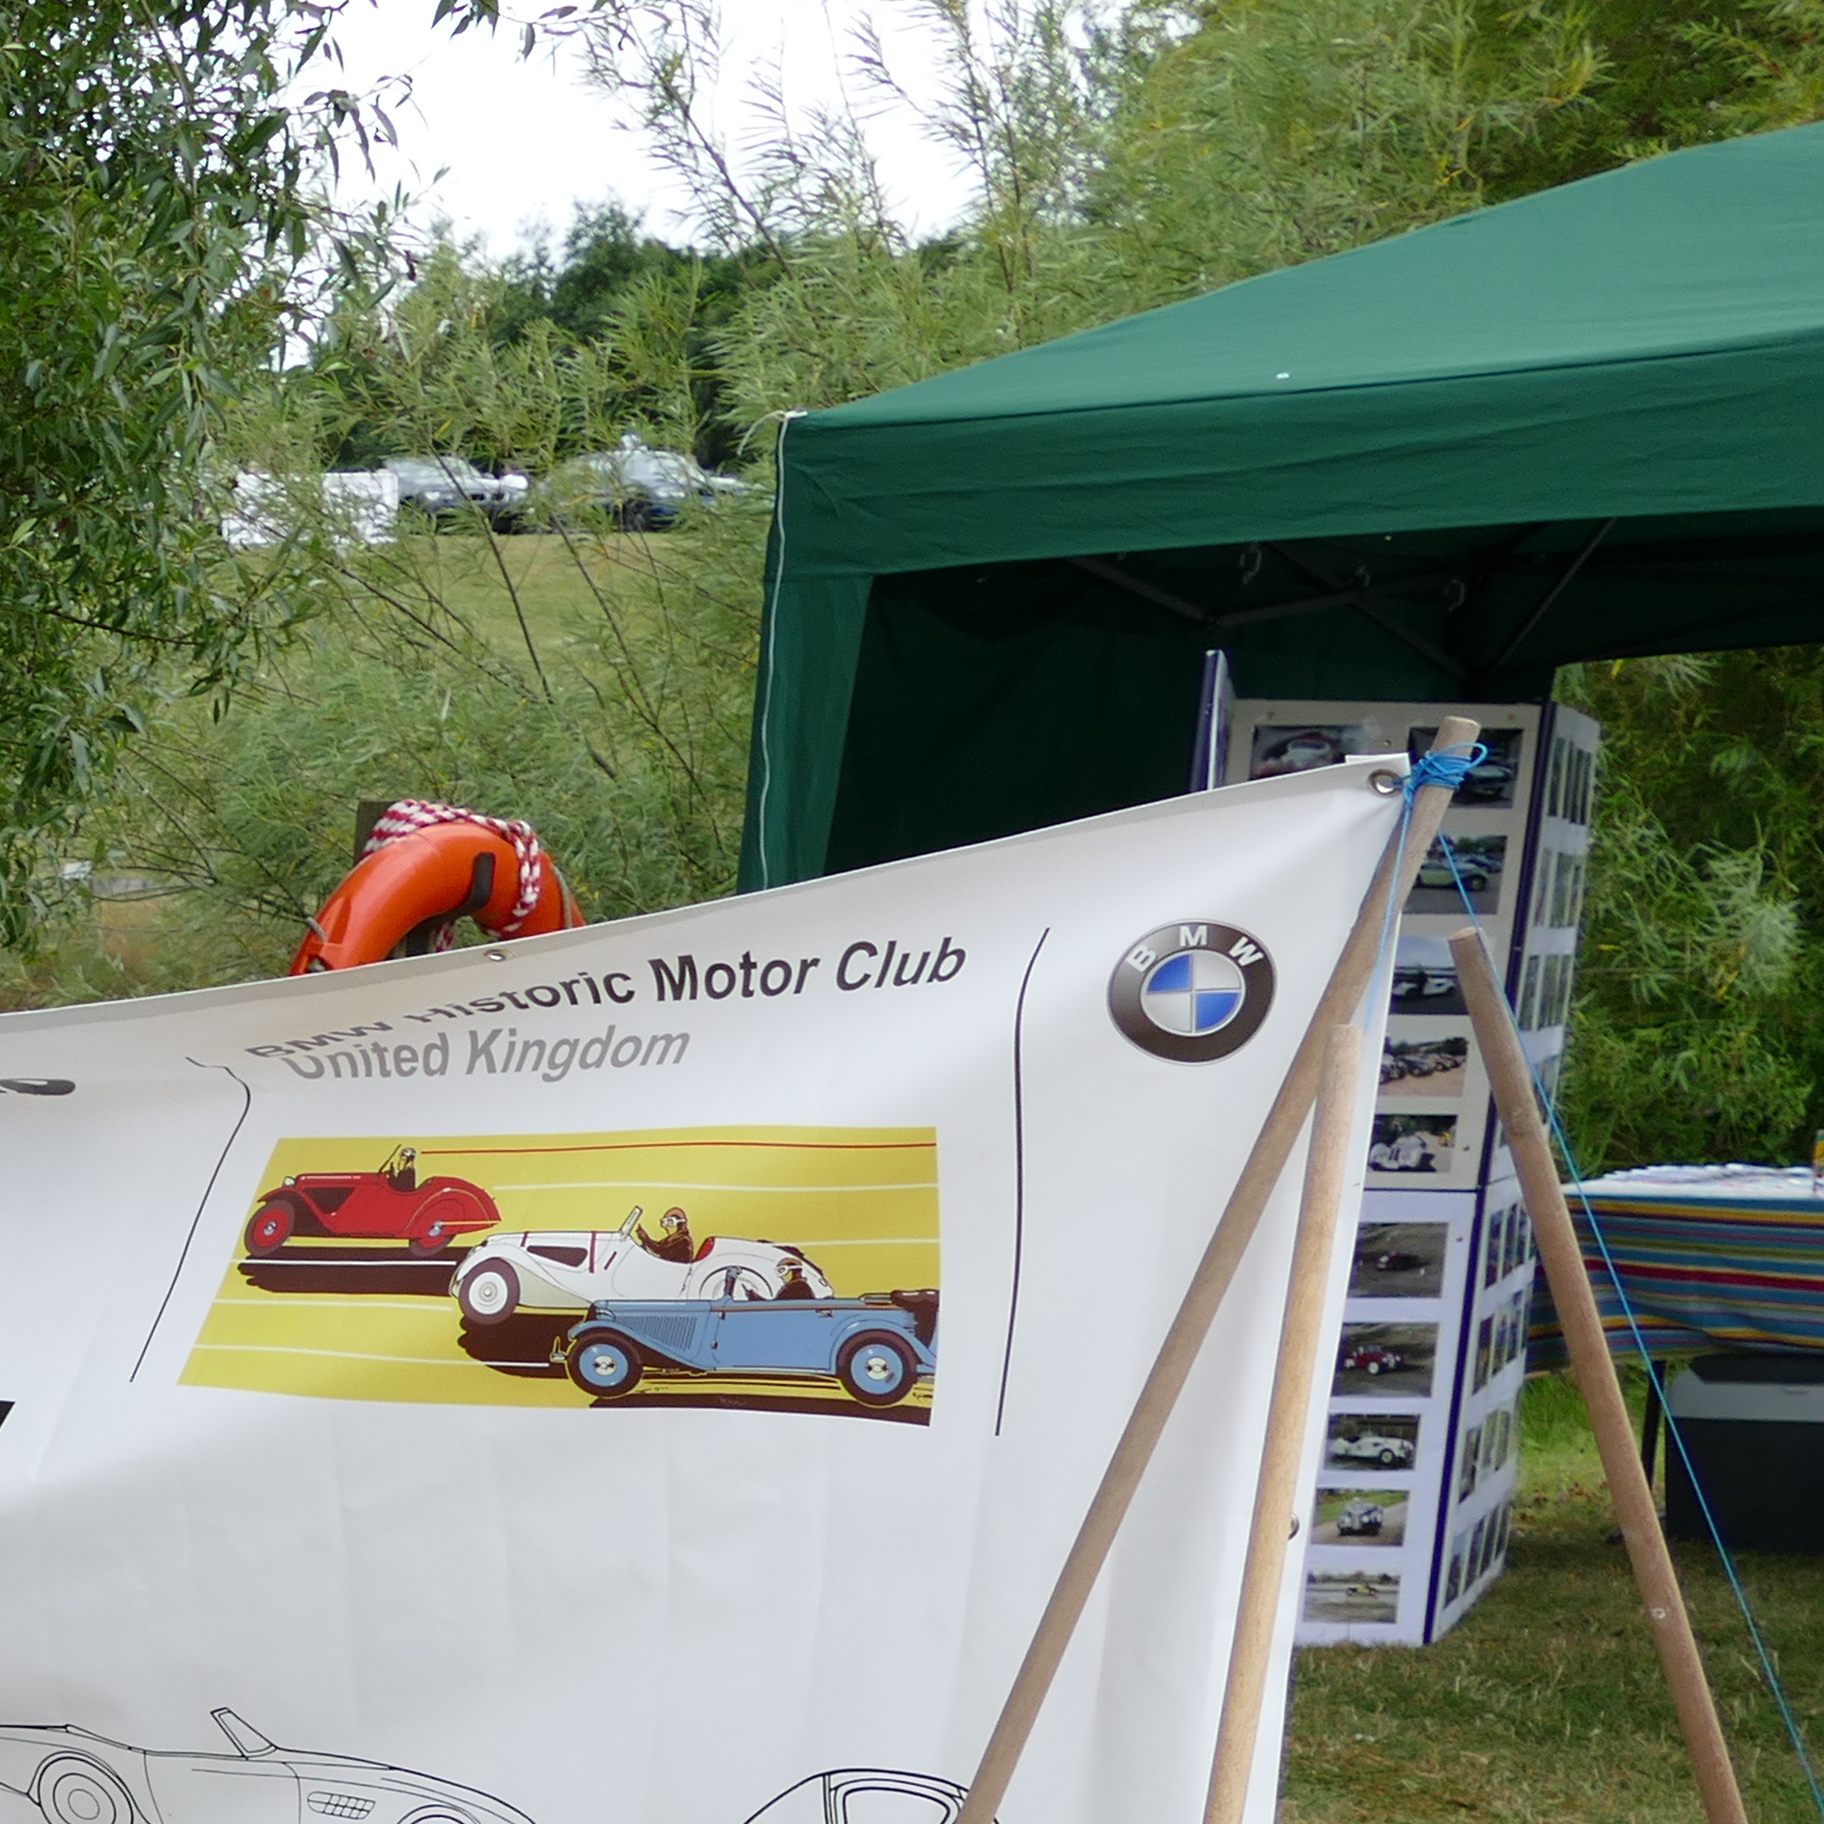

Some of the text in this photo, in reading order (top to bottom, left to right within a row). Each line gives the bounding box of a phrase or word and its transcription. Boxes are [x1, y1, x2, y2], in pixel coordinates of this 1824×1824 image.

[1126, 925, 1264, 972] BMW
[245, 936, 966, 1059] BMW Historic Motor Club
[282, 1024, 691, 1083] United Kingdom
